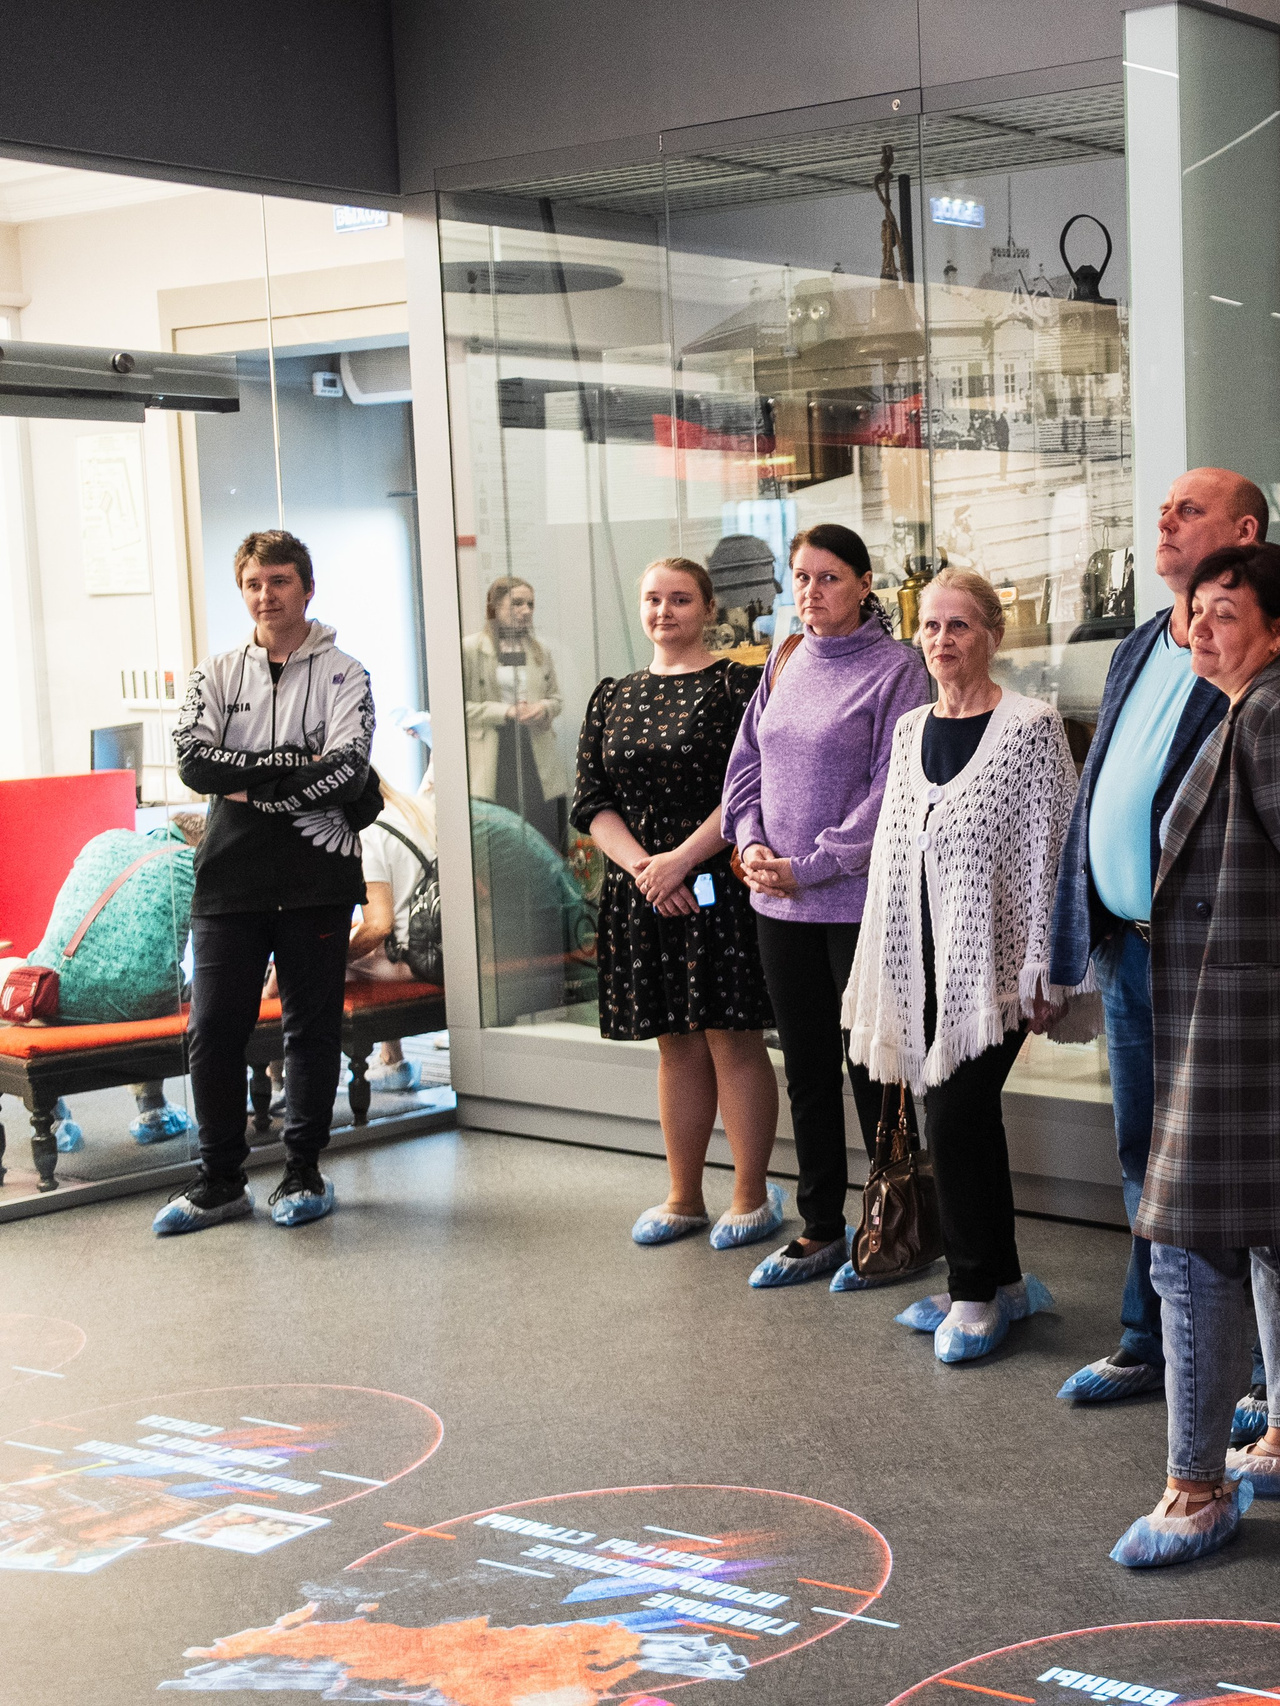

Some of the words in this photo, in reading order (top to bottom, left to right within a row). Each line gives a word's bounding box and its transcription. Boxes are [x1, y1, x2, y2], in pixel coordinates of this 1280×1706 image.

[302, 763, 355, 801] RUSSIA
[135, 1413, 225, 1438] СОЮЗА
[136, 1433, 290, 1470] СОВЕТСКОГО
[473, 1513, 597, 1545] СТРАНЫ
[594, 1537, 727, 1572] ЦЕНТРЫ
[519, 1543, 791, 1609] ПРОМЫШЛЕННЫЕ
[639, 1592, 801, 1636] ГЛАВНЫЕ
[1036, 1666, 1181, 1706] ВОЙНЫ
